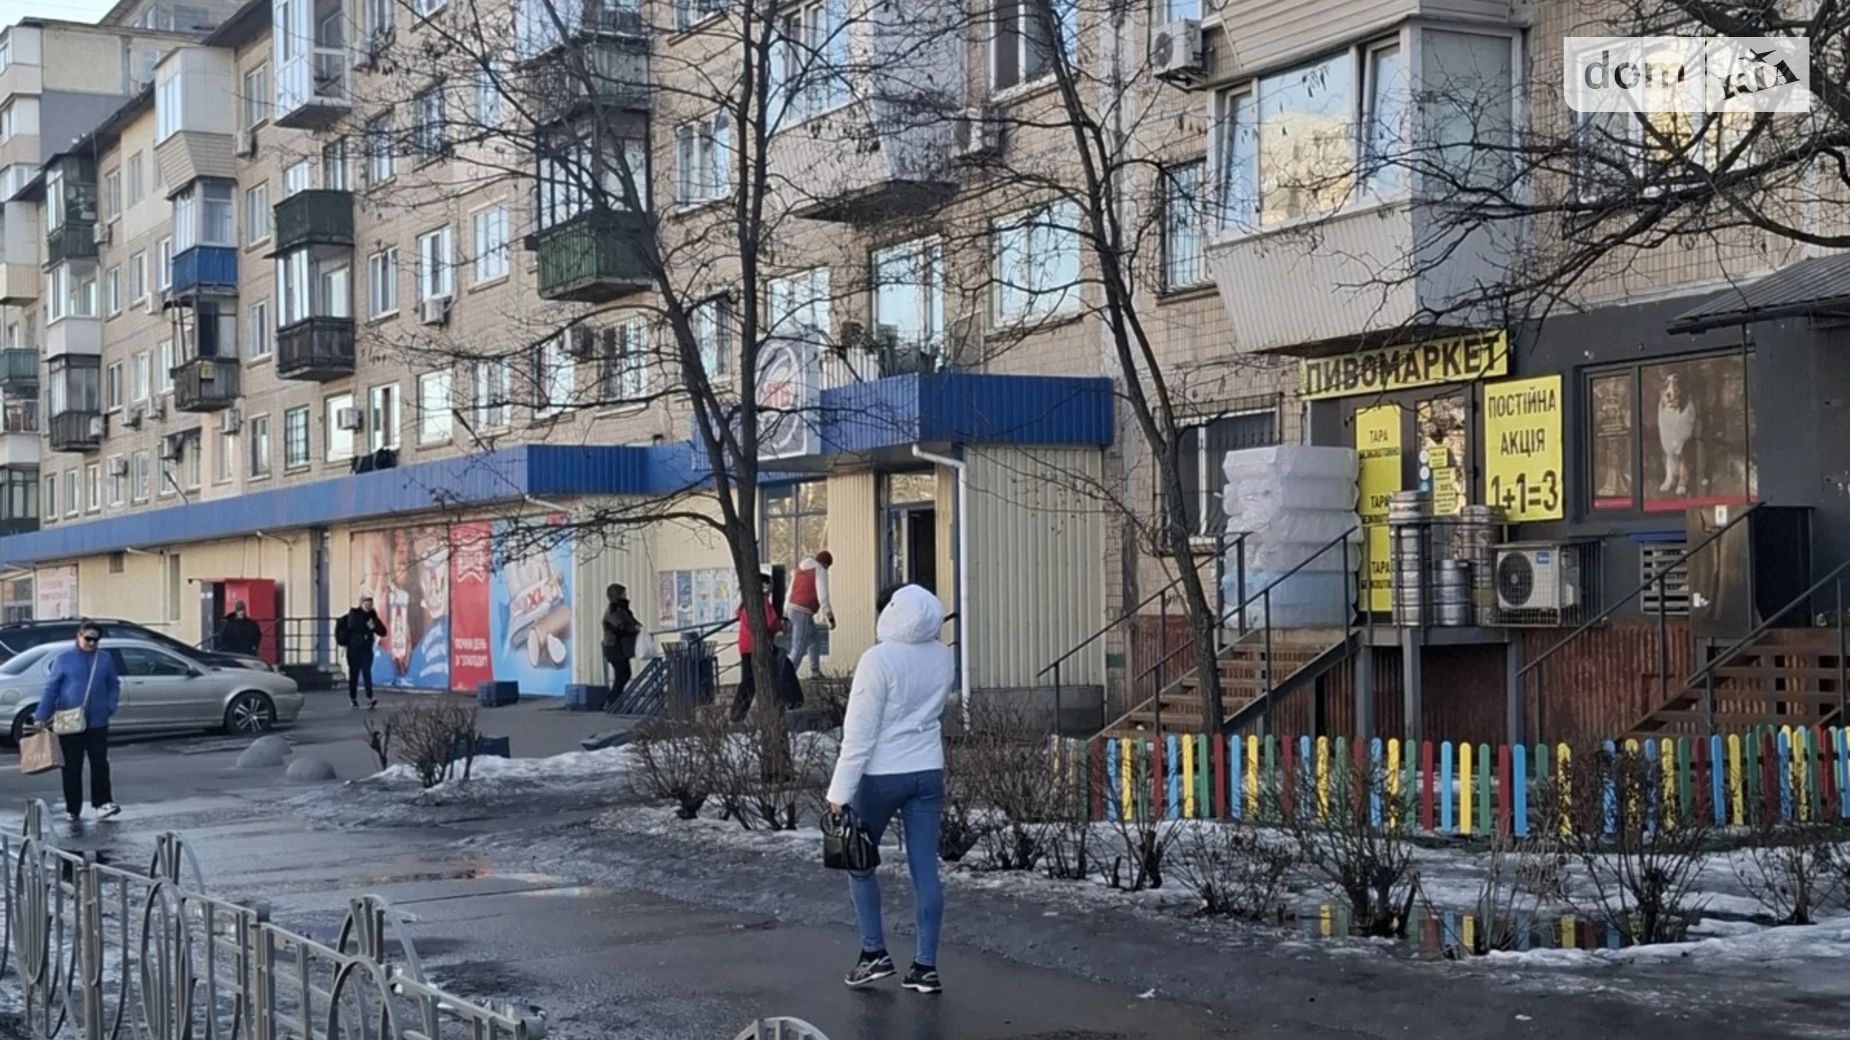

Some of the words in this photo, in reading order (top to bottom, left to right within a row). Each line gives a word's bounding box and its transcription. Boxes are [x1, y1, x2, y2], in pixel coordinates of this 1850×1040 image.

[1306, 336, 1500, 395] ПИВОМАРКЕТ
[1488, 385, 1556, 419] ПОСТІЙНА
[1369, 429, 1389, 444] ТАРА
[1500, 428, 1546, 458] АКЦІЯ
[1490, 469, 1559, 514] 1+1=3
